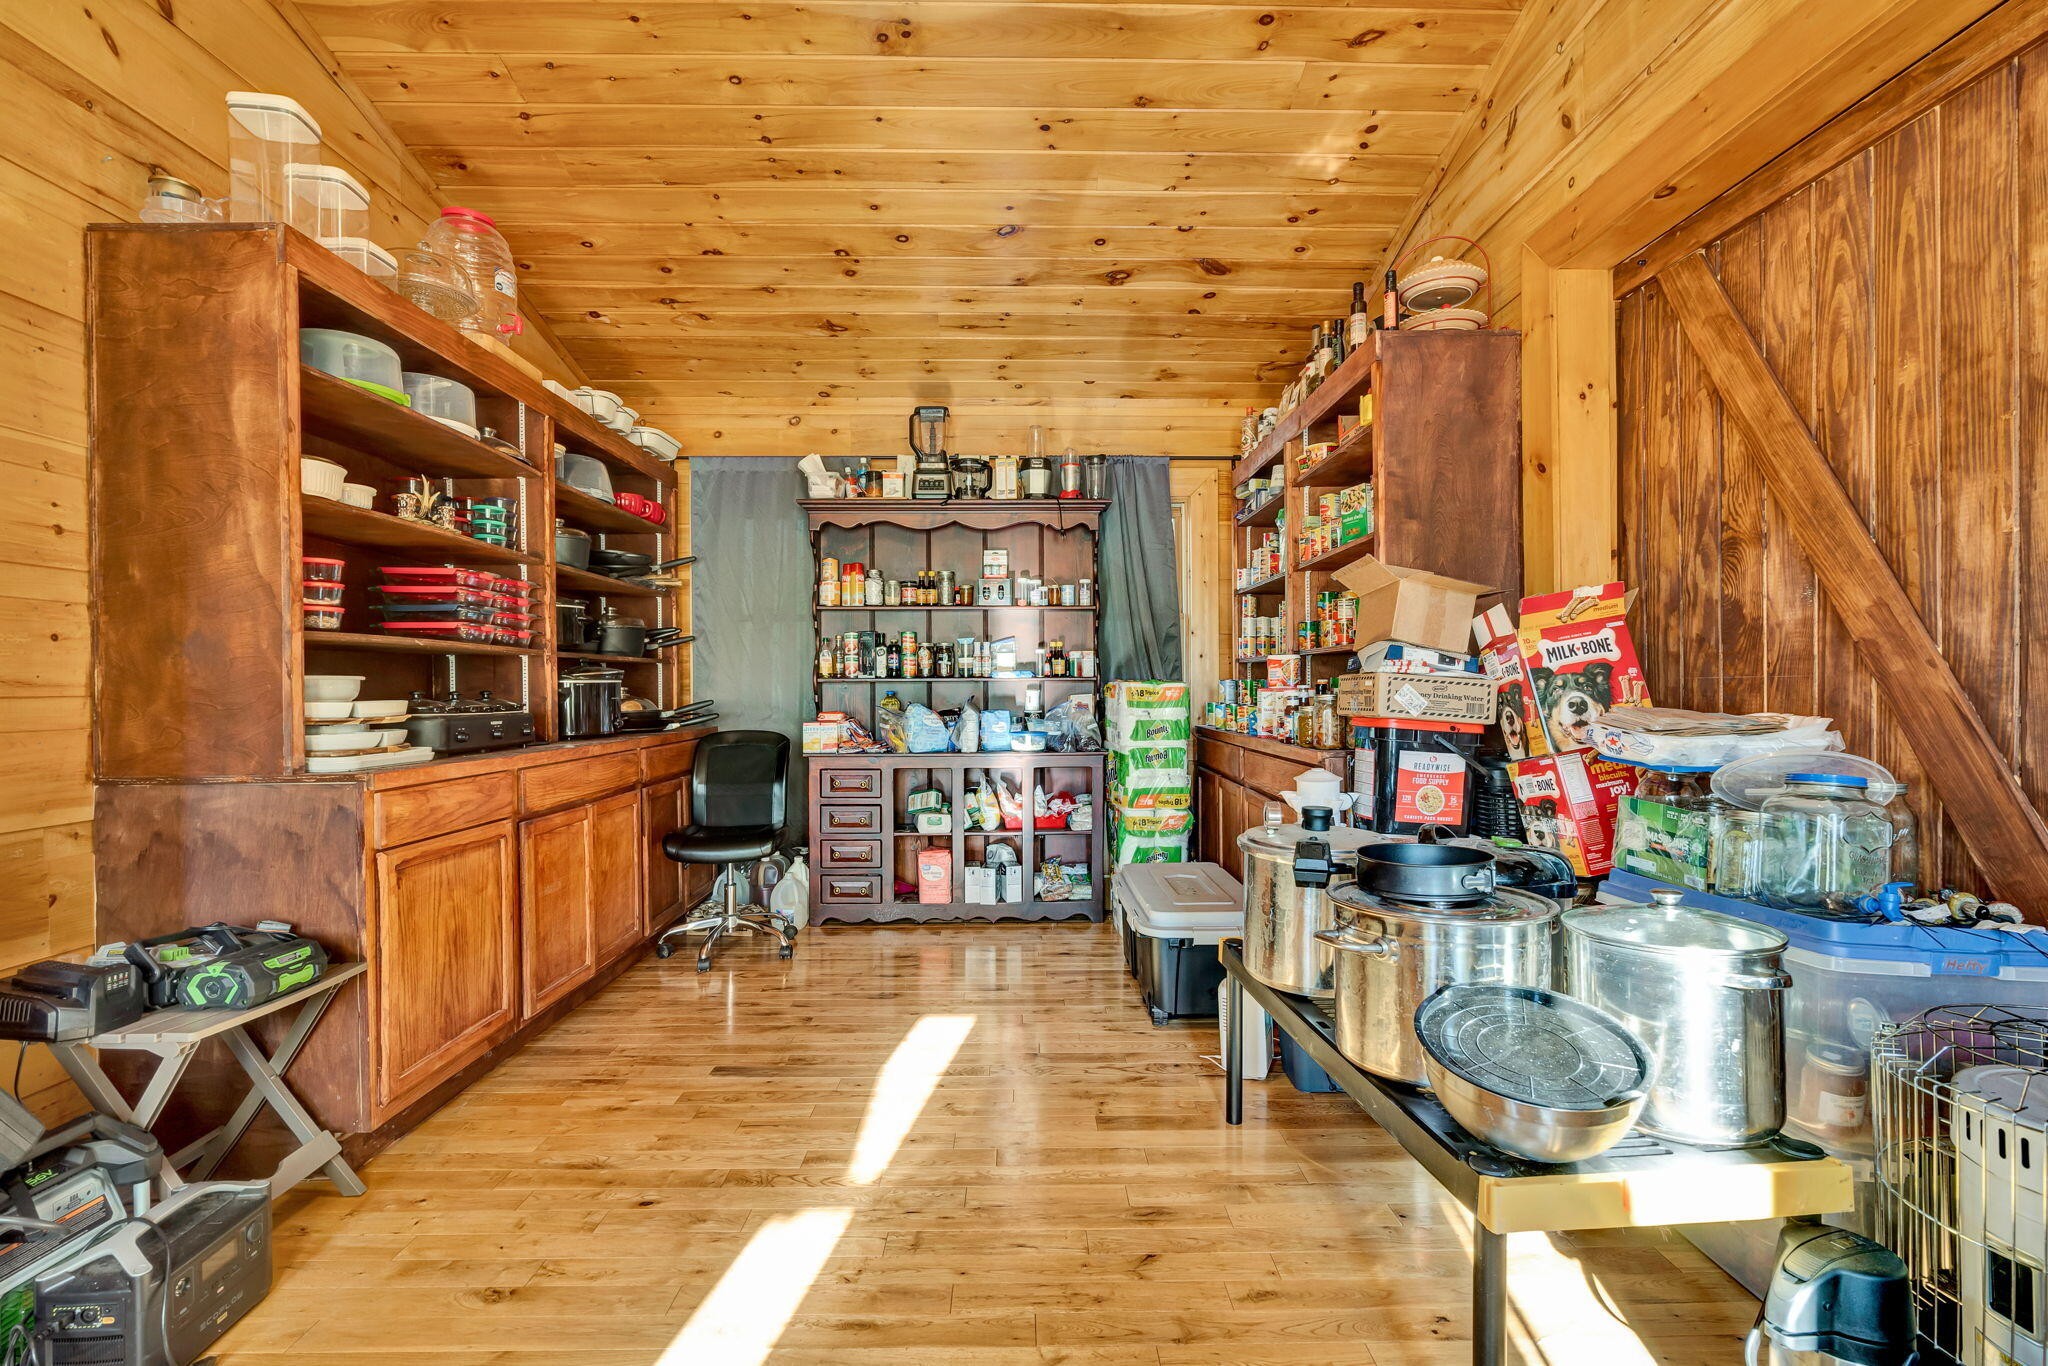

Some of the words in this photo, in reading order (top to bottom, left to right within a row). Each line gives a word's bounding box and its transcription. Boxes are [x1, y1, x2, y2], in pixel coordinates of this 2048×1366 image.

[1593, 603, 1618, 612] medium
[1546, 643, 1578, 663] MILK
[1581, 637, 1613, 655] BONE
[1505, 662, 1520, 678] BONE
[1433, 692, 1463, 702] Drinking
[1464, 694, 1484, 702] Water
[1146, 725, 1169, 738] Bounty
[1413, 762, 1451, 772] READYWISE
[1412, 777, 1427, 785] FOOD
[1428, 778, 1449, 786] SUPPLY
[1598, 770, 1629, 781] biscuits,
[1537, 778, 1555, 791] BONE
[1596, 780, 1624, 789] maximum
[1610, 782, 1631, 798] joy!
[1945, 959, 1988, 975] Hefty
